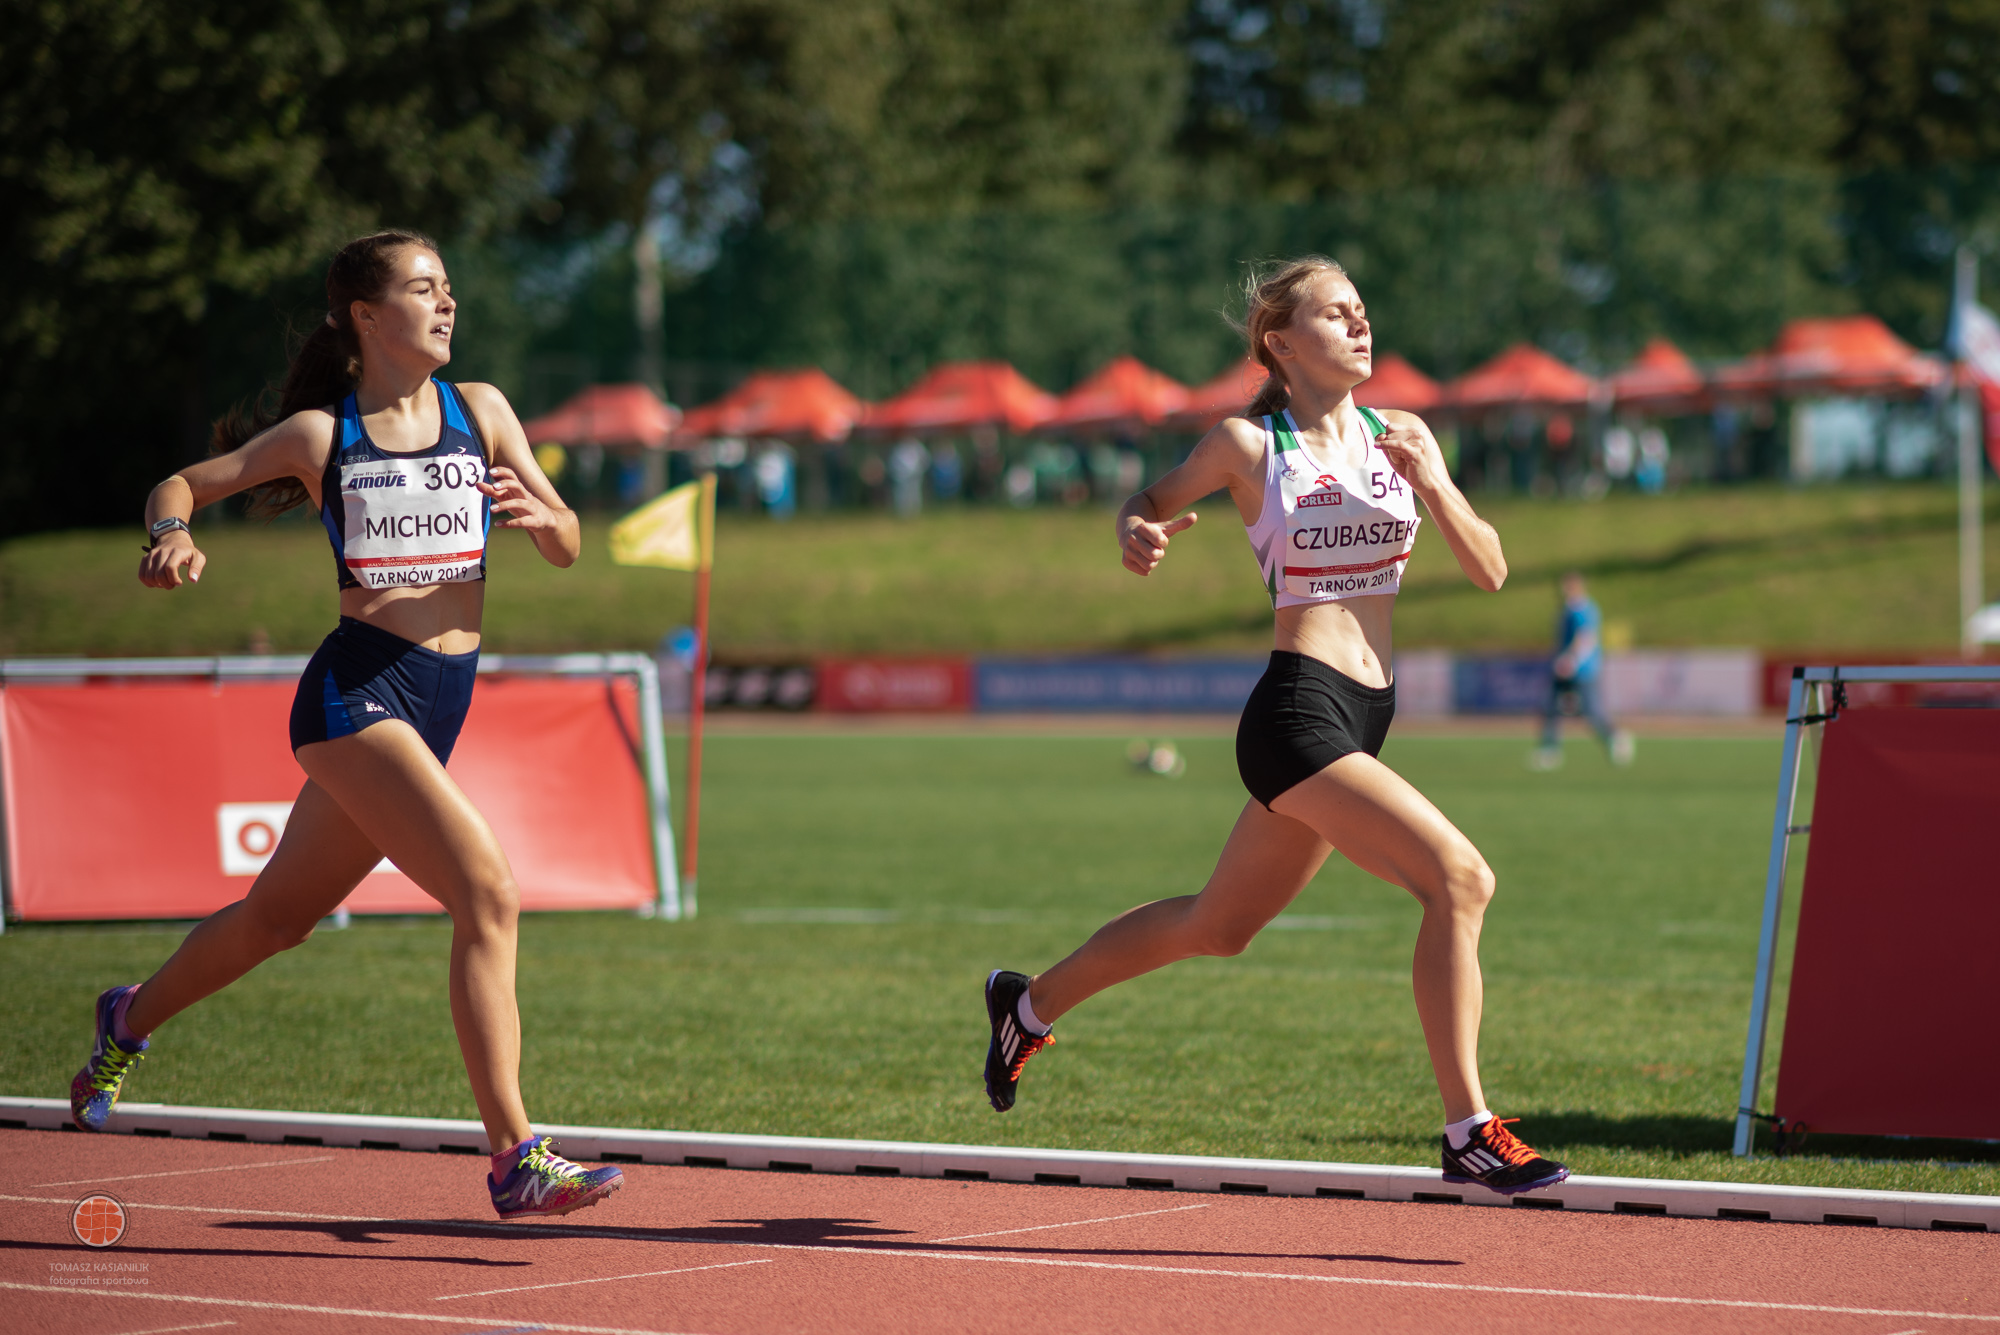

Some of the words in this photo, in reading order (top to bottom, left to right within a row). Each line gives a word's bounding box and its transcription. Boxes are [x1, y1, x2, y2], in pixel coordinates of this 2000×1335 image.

[348, 475, 407, 490] 4MOVE
[423, 462, 480, 491] 303
[1371, 471, 1403, 499] 54
[1299, 494, 1340, 507] ORLEN
[366, 507, 469, 540] MICHOŃ
[1293, 519, 1417, 550] CZUBASZEK
[369, 567, 434, 585] TARNÓW
[437, 566, 468, 581] 2019
[1309, 575, 1369, 594] TARNÓW
[1370, 569, 1395, 588] 2019
